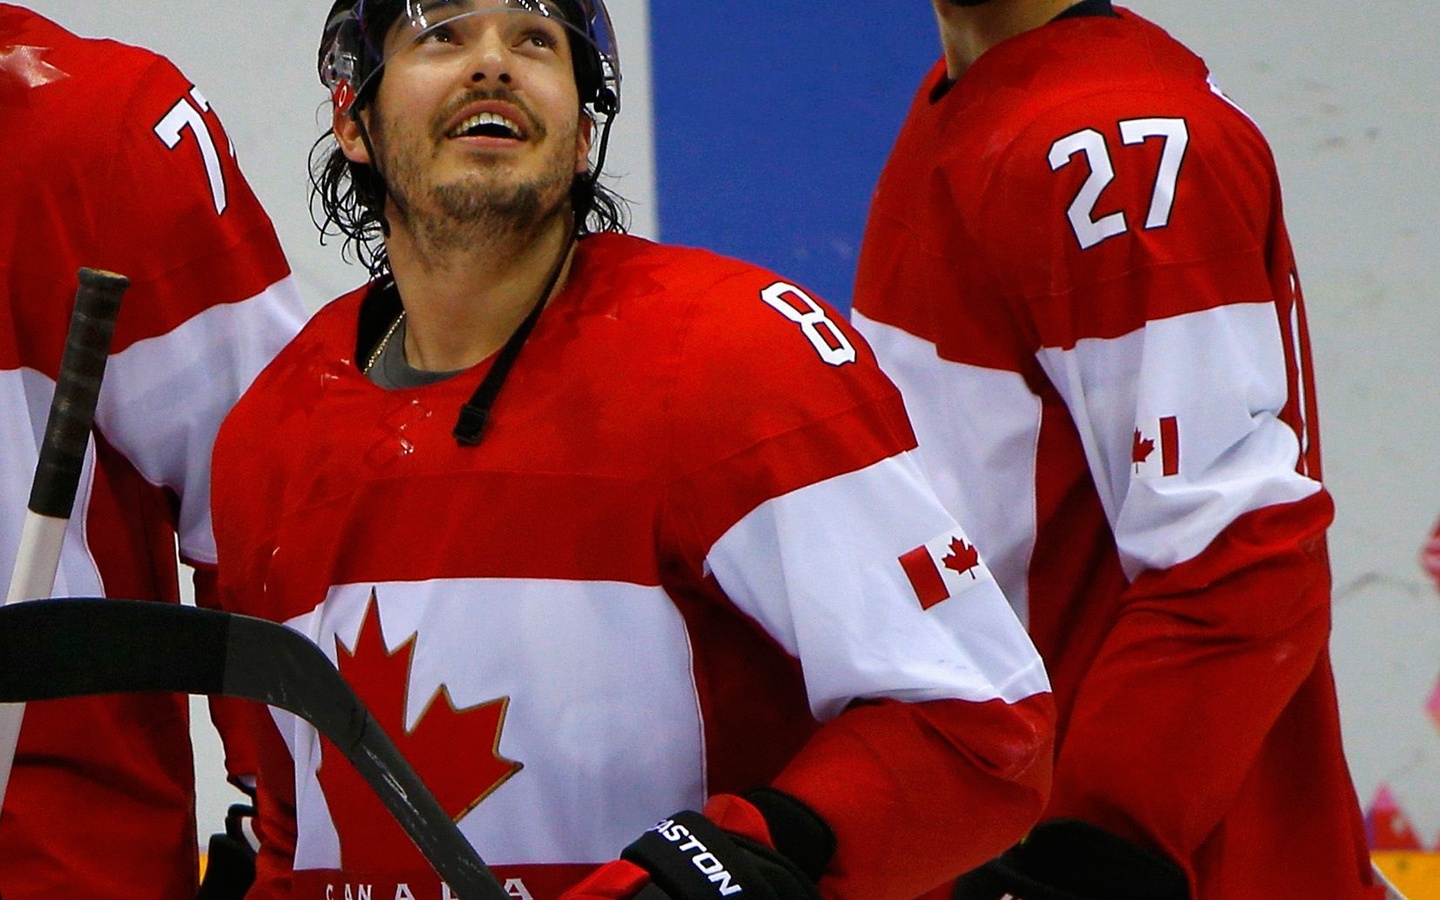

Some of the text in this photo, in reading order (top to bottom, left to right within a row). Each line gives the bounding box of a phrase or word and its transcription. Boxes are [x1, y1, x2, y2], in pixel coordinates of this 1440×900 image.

[1047, 117, 1189, 250] 27
[760, 281, 856, 366] 8
[647, 819, 742, 896] ASTON
